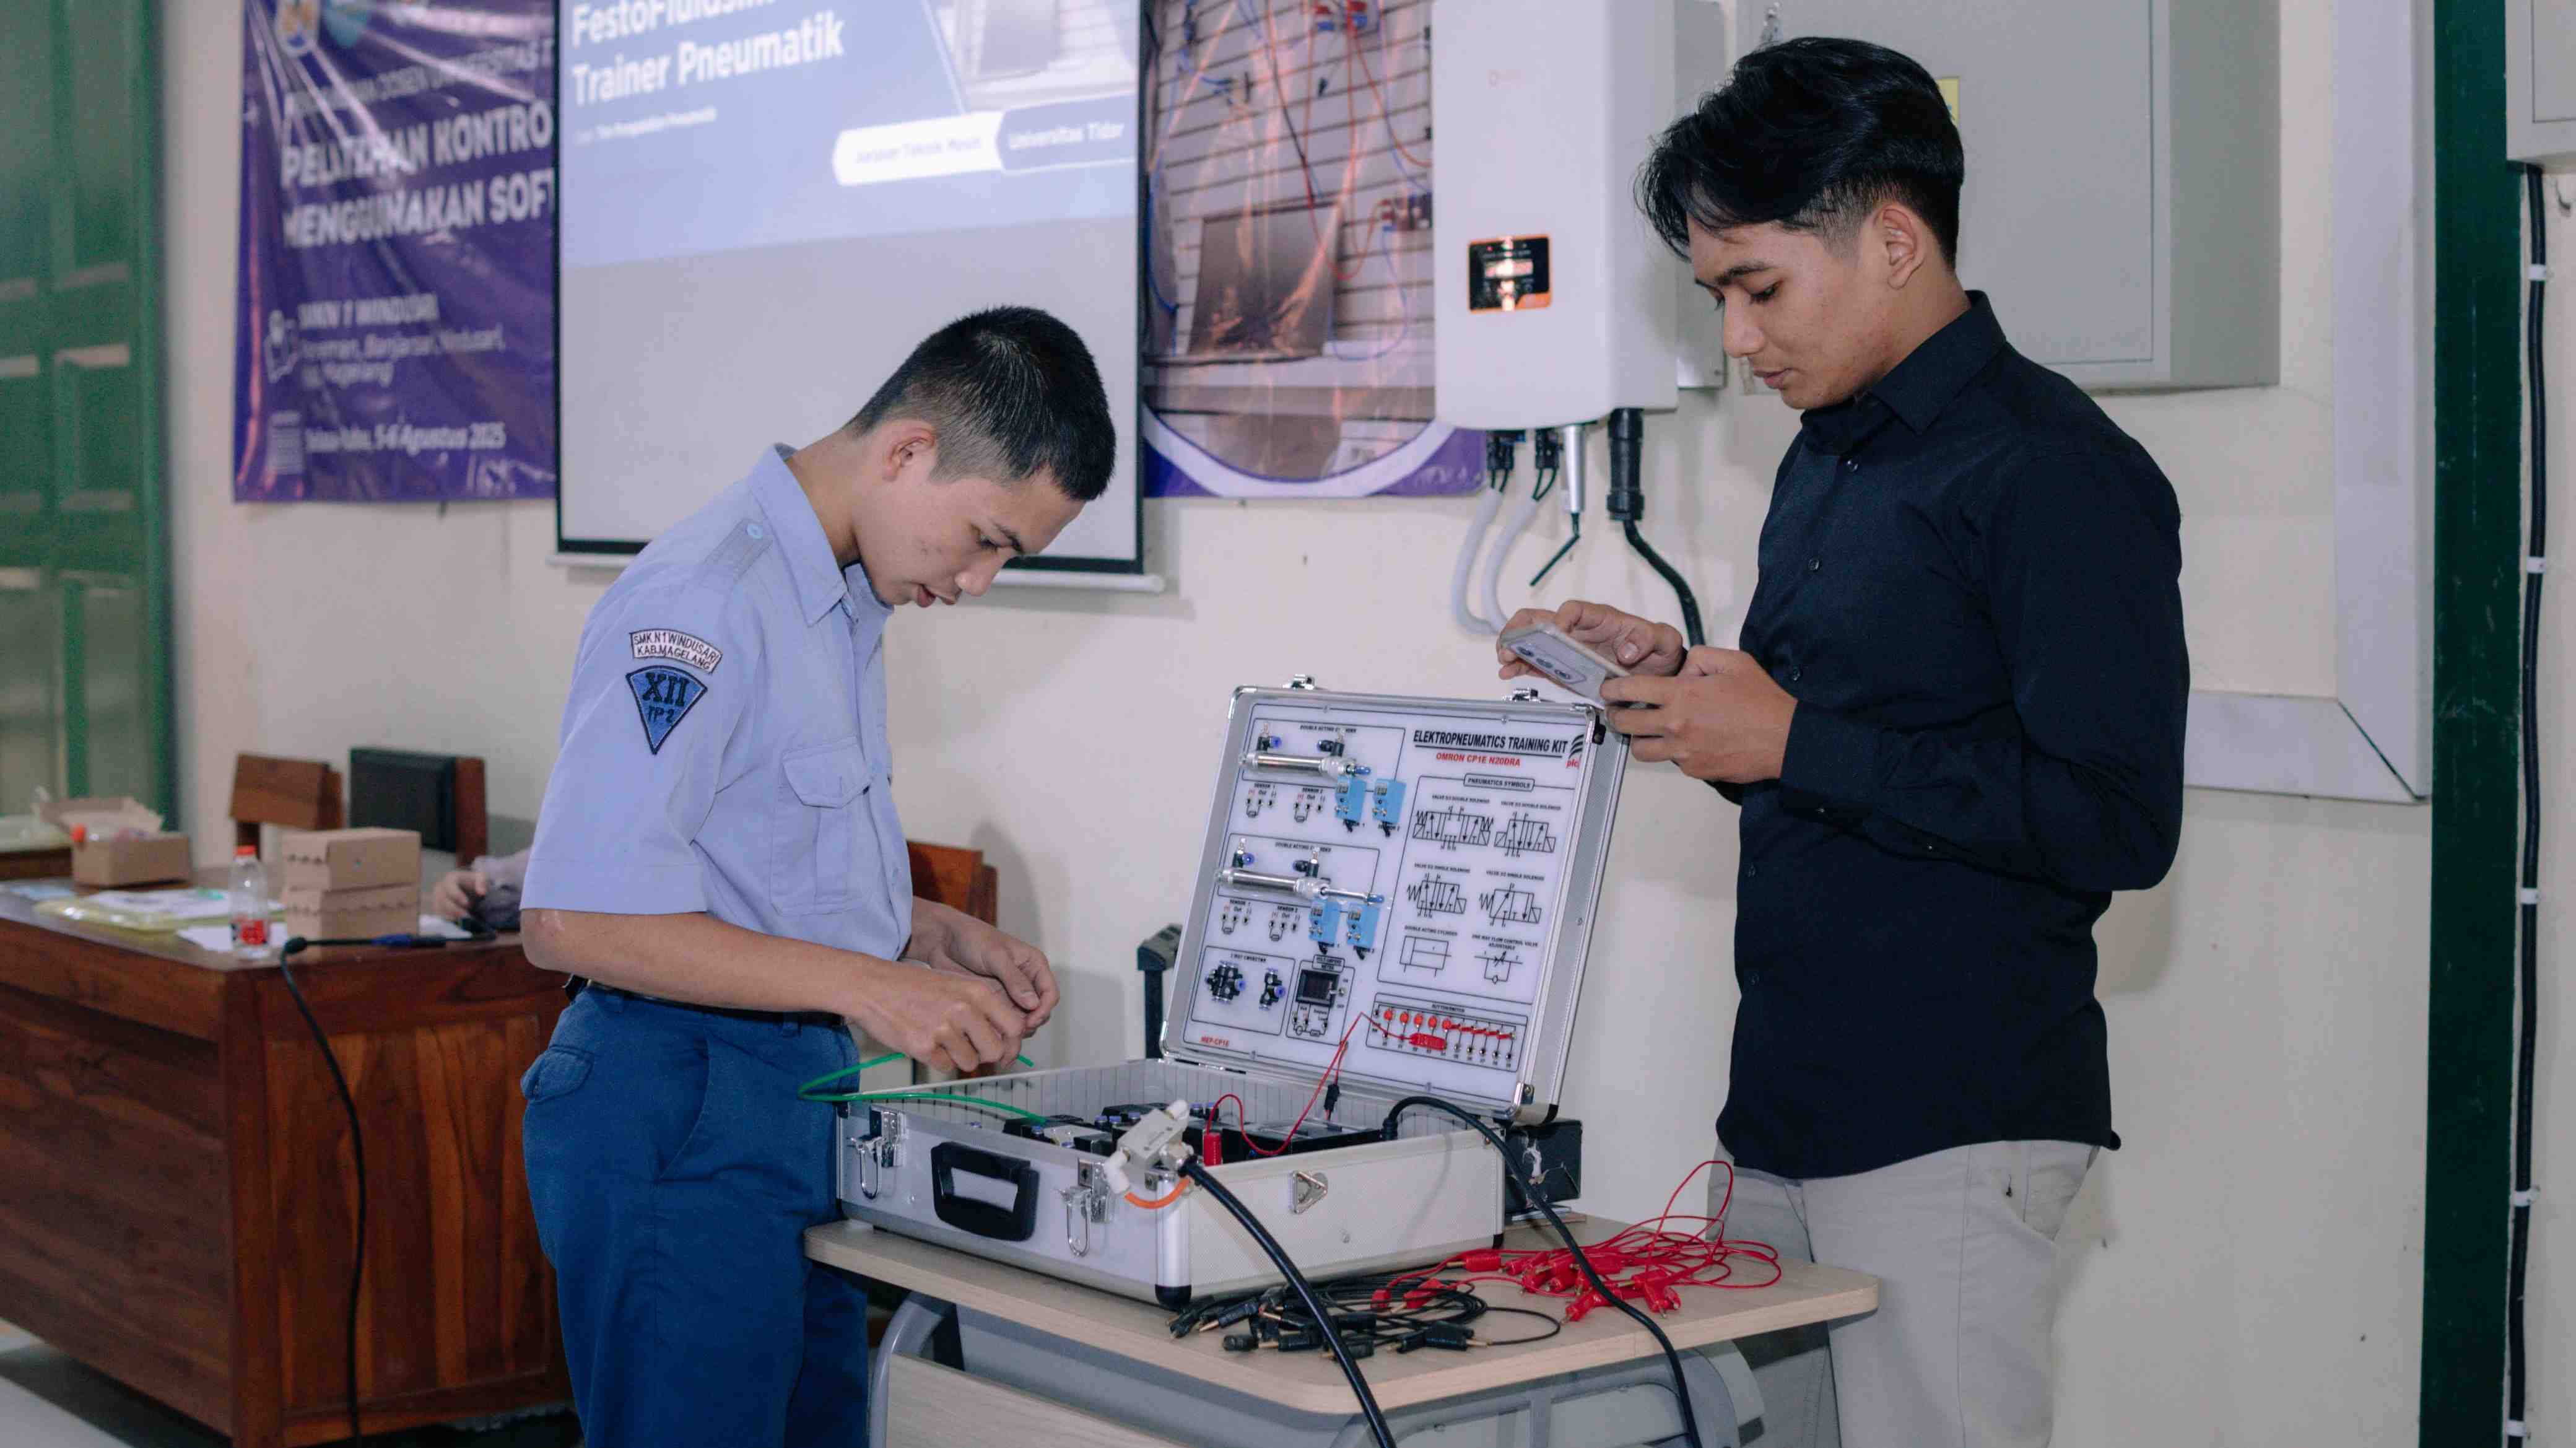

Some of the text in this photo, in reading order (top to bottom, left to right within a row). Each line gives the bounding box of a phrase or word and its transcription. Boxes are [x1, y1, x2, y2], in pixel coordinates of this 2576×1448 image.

[572, 9, 845, 107] Trainer Pneumatik
[1008, 128, 1084, 150] Universitas
[400, 424, 468, 456] Agustus
[668, 632, 719, 663] WINDUSARI
[642, 673, 690, 707] XII
[648, 706, 664, 723] TP
[1413, 730, 1568, 753] ELEKTROPNEUMATICS TRAINING KIT
[1436, 752, 1521, 767] OMRON CP1E N20DRA
[1468, 778, 1531, 789] PNEUMATICS SYMBOLS
